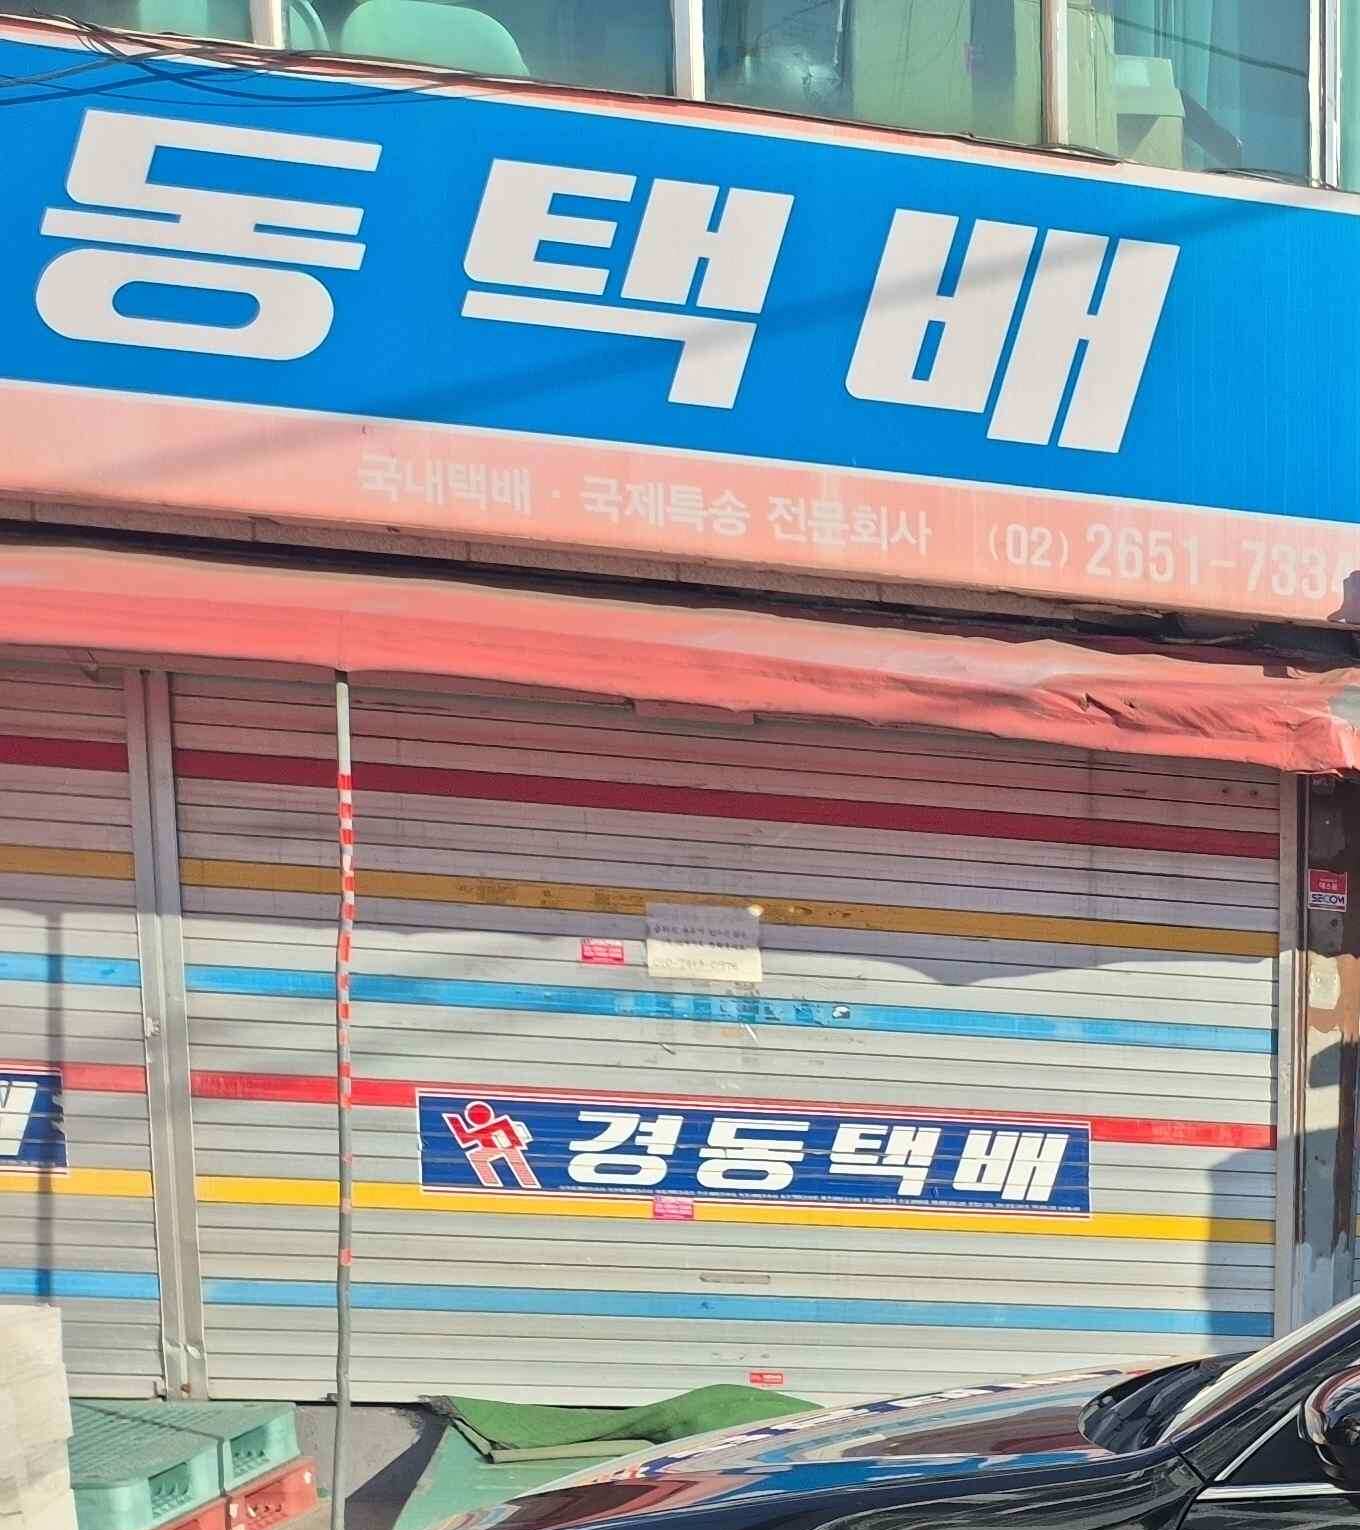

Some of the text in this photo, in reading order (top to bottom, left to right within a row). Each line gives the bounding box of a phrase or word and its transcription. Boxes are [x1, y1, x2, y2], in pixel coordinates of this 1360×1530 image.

[358, 453, 532, 513] 국내택배
[581, 475, 752, 536] 국제특송
[988, 525, 1070, 571] (02)
[567, 1110, 1070, 1202] 경동택배
